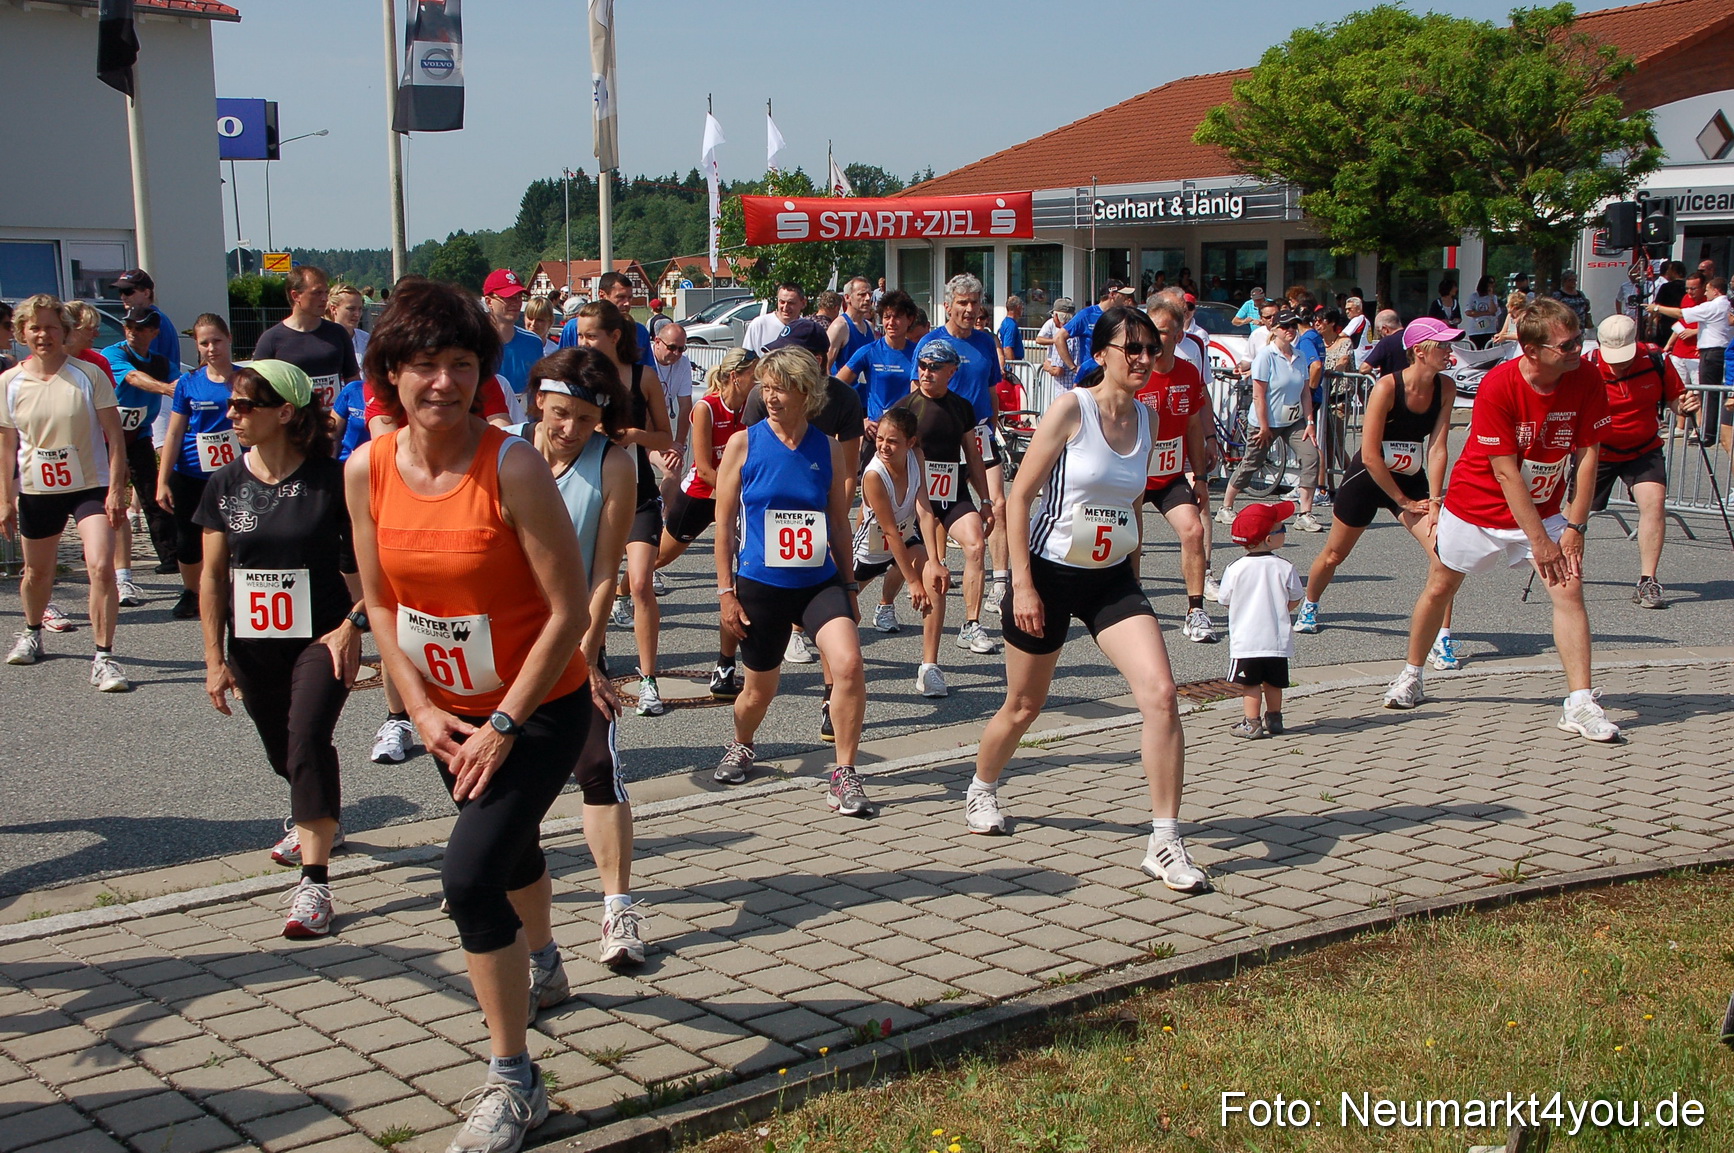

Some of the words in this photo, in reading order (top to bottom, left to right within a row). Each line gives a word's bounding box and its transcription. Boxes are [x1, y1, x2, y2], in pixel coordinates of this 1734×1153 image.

[1092, 197, 1165, 220] Gerhart
[1170, 196, 1183, 216] &
[1188, 191, 1243, 219] Jänig
[1587, 261, 1628, 269] SEAT
[121, 409, 140, 427] 73
[1289, 405, 1300, 421] 72
[208, 443, 235, 467] 28
[1158, 450, 1176, 471] 15
[41, 462, 72, 488] 65
[929, 474, 951, 497] 70
[1531, 473, 1558, 499] 25
[1084, 508, 1116, 518] MEYER
[1084, 516, 1117, 524] WERBUNG
[778, 527, 813, 560] 93
[1091, 525, 1113, 562] 5
[246, 573, 279, 582] MEYER
[250, 592, 294, 631] 50
[409, 613, 449, 632] MEYER
[409, 624, 451, 639] WERBUNG
[424, 642, 474, 690] 61
